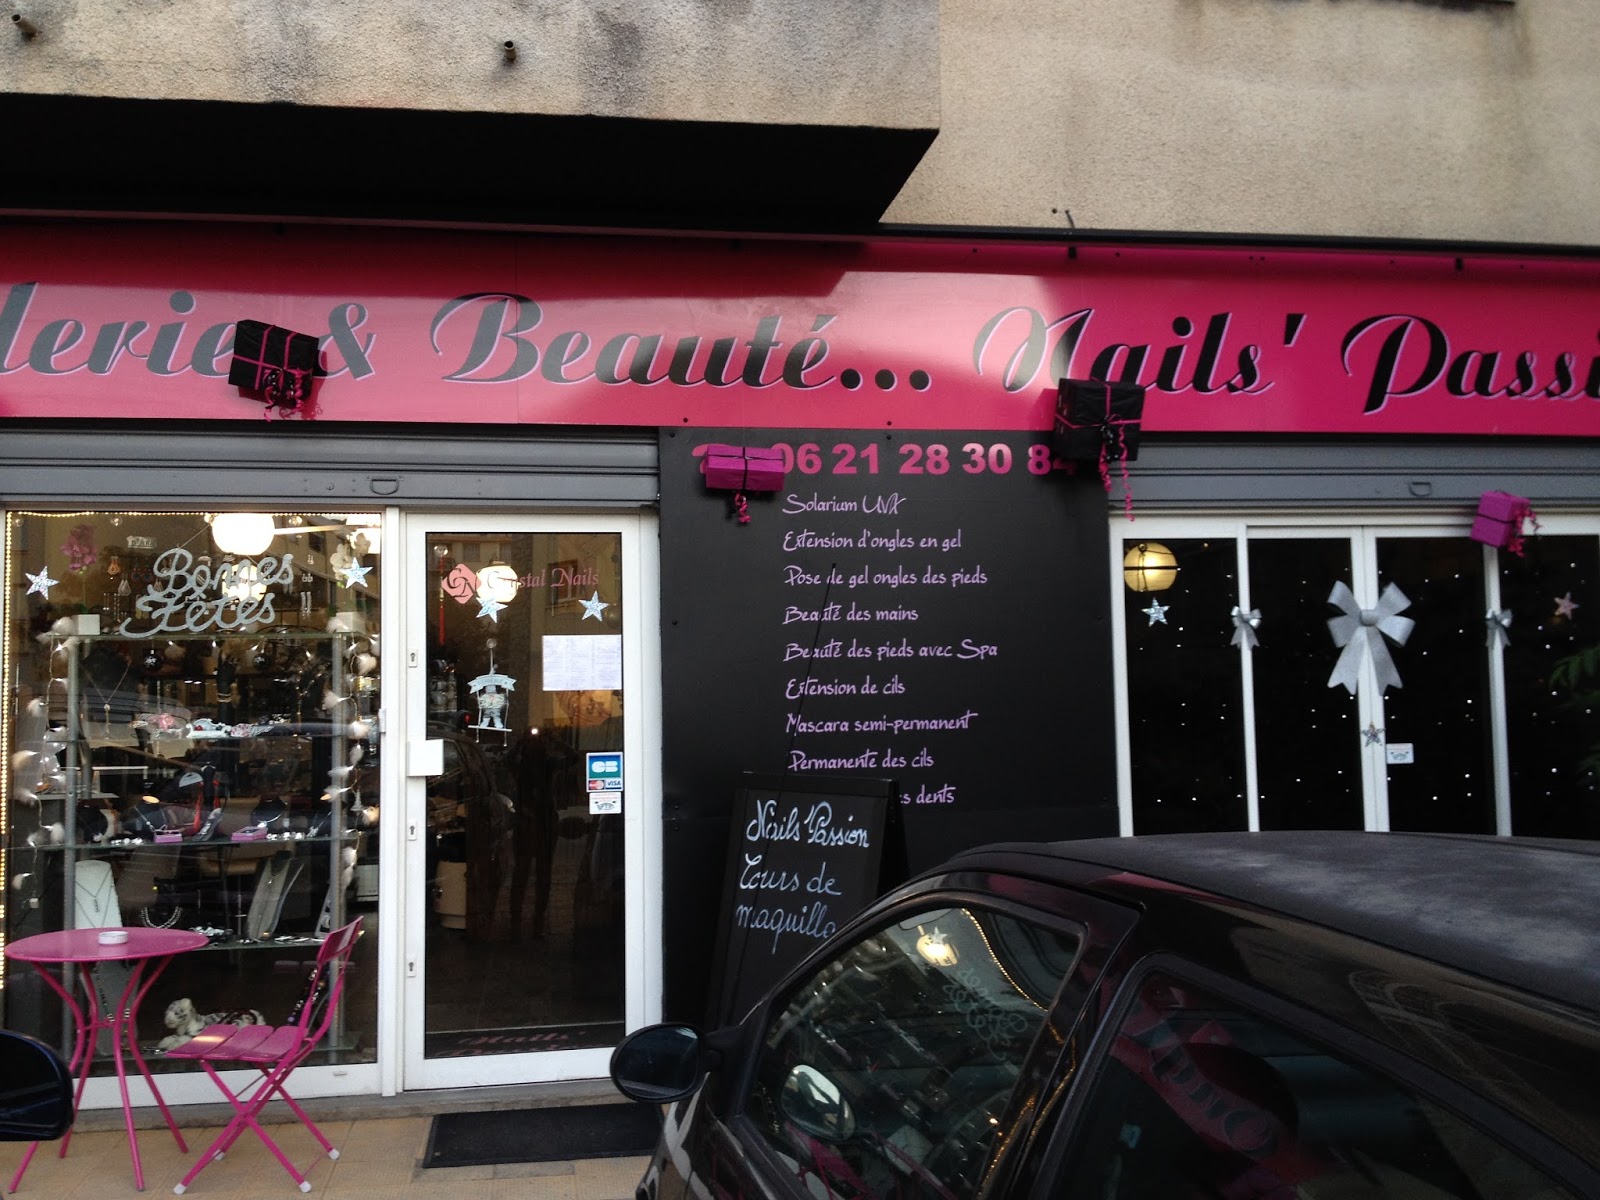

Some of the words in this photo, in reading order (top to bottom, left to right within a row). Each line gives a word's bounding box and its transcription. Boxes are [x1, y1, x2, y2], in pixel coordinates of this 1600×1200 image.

[832, 443, 879, 475] 21
[899, 443, 951, 475] 28
[962, 442, 1013, 475] 30
[781, 491, 858, 515] Solarium
[782, 528, 854, 552] Extension
[858, 528, 915, 552] d'ongles
[919, 537, 938, 549] en
[942, 528, 962, 552] gel
[487, 569, 546, 593] Cstal
[550, 567, 600, 588] Nails
[783, 564, 822, 587] Pose
[826, 565, 844, 585] de
[848, 564, 869, 589] gel
[873, 564, 918, 589] ongles
[922, 564, 947, 585] des
[951, 564, 988, 588] pieds
[782, 602, 843, 625] Beauté
[846, 602, 872, 621] des
[876, 604, 919, 621] mains
[782, 638, 843, 662] Beauté
[847, 638, 873, 658] des
[877, 638, 915, 662] pieds
[918, 645, 953, 658] avec
[956, 638, 998, 660] Spa
[785, 676, 857, 700] Extension
[861, 674, 879, 695] de
[882, 674, 906, 695] cils
[785, 713, 850, 737] Mascara
[854, 709, 979, 735] semi-permanent
[787, 748, 878, 772] Permanente
[881, 748, 907, 768] des
[911, 747, 934, 768] cils
[915, 783, 957, 805] dents
[745, 799, 801, 842] Nails
[804, 801, 870, 848] Passion
[806, 861, 842, 896] de
